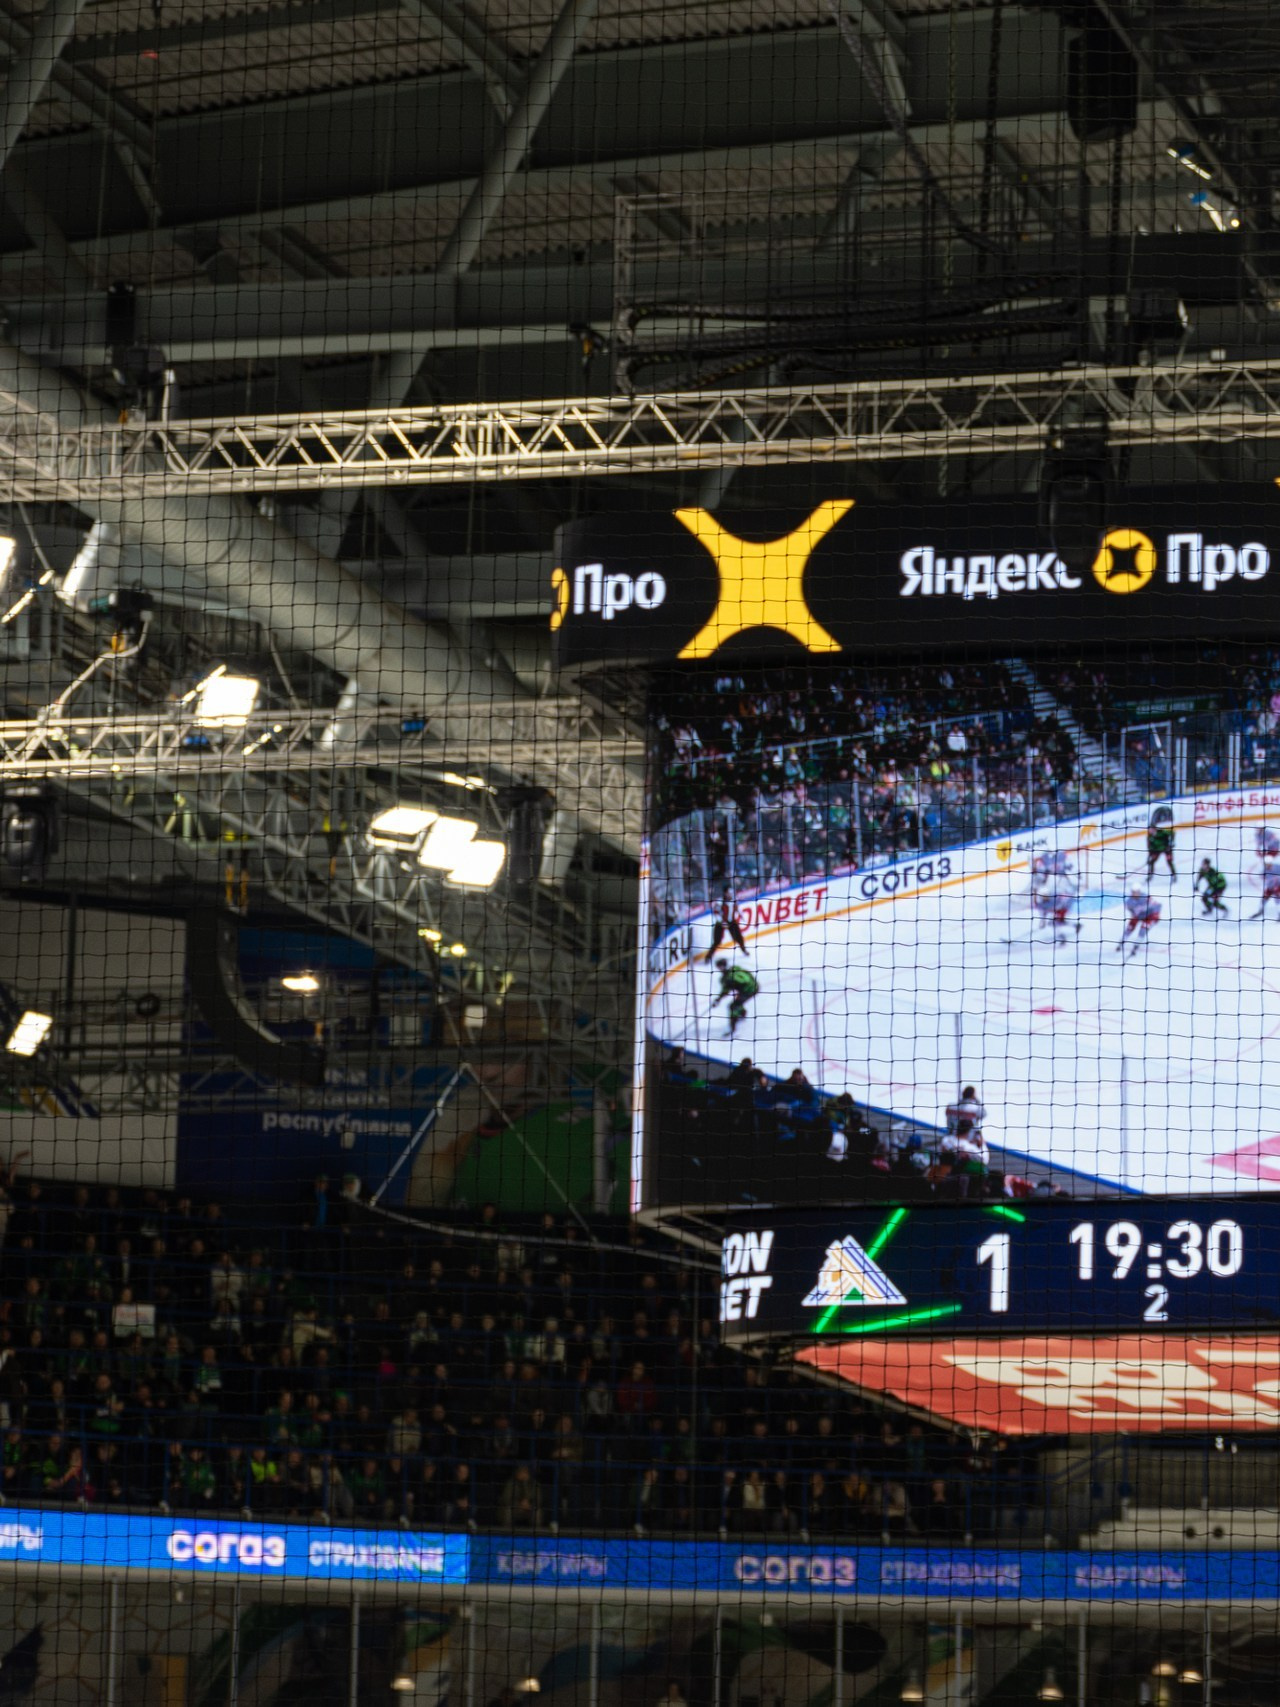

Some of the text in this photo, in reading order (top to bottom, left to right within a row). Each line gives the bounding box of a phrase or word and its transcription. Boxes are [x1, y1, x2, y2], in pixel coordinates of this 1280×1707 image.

[1166, 532, 1271, 591] Про
[573, 562, 667, 620] Про
[720, 886, 829, 937] ONBET
[721, 1230, 775, 1276] ON
[976, 1233, 1012, 1313] 1
[1068, 1218, 1246, 1281] 19:30
[719, 1275, 774, 1323] ET
[1143, 1284, 1170, 1323] 2
